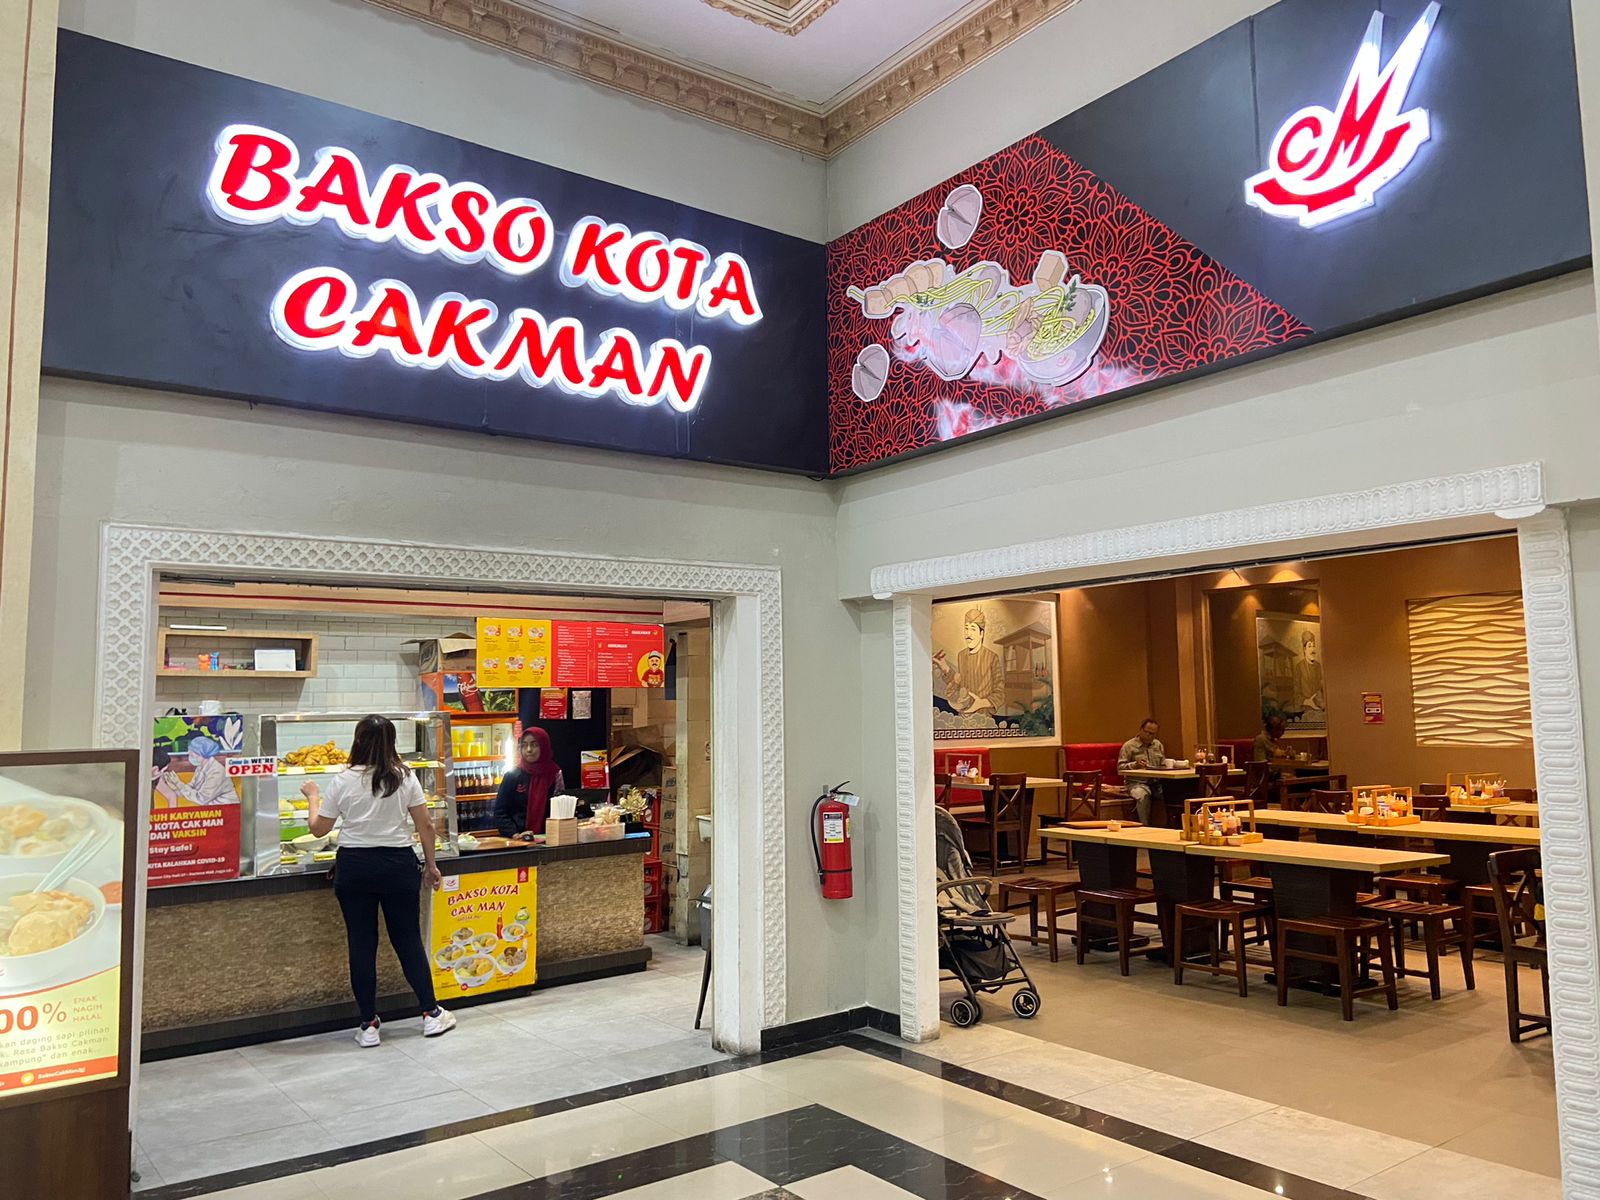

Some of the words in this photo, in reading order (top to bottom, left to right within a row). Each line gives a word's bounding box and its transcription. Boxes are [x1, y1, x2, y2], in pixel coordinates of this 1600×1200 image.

[214, 129, 549, 268] BAKSO
[565, 219, 760, 321] KOTA
[277, 271, 708, 408] CAKMAN
[228, 764, 273, 775] OPEN
[170, 810, 222, 821] KARYAWAN
[155, 821, 180, 831] KOTA
[181, 820, 201, 829] CAK
[202, 818, 224, 827] MAN
[172, 828, 207, 839] VAKSIN
[149, 846, 170, 855] Stay
[170, 843, 192, 853] Safe!
[197, 857, 225, 865] COVID-19
[447, 886, 488, 906] BAKSO
[490, 884, 519, 895] KOTA
[451, 905, 473, 917] CAK
[477, 901, 505, 912] MAN
[72, 1014, 102, 1023] HALAL
[20, 1035, 52, 1048] daging
[56, 1032, 75, 1041] sapi
[79, 1026, 110, 1038] pilihan
[14, 1047, 36, 1056] Rasa
[40, 1041, 68, 1052] Bakso
[50, 1051, 68, 1060] dan
